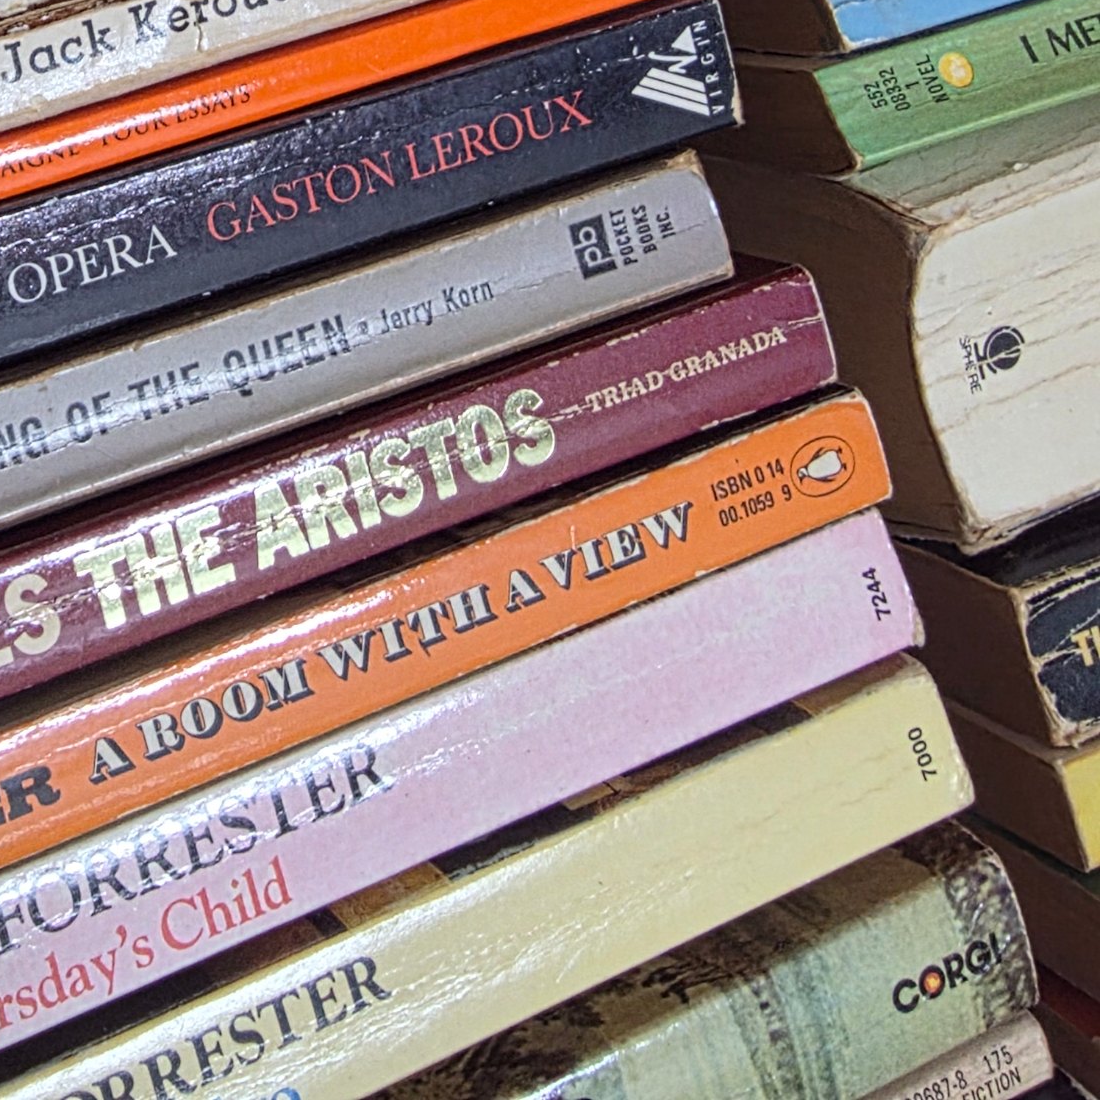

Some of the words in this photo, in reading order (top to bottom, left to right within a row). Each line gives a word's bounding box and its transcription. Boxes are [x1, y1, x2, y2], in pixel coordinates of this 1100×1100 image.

[2, 17, 119, 85] Jack
[693, 19, 723, 116] VIRGIN
[1020, 35, 1039, 63] I
[176, 83, 251, 124] ESSAYS
[864, 81, 888, 109] 552
[879, 66, 912, 112] 08332
[905, 81, 919, 90] 1
[916, 54, 950, 103] NOVEL
[207, 150, 395, 242] GASTON
[406, 89, 594, 180] LEROUX
[609, 209, 638, 266] POCKET
[631, 204, 657, 254] BOOKS
[656, 205, 676, 240] INC.
[7, 223, 177, 305] OPERA
[66, 391, 112, 443] OF
[127, 361, 210, 419] THE
[222, 314, 352, 397] QUEEN
[380, 299, 434, 335] Jerry
[441, 280, 495, 315] Korn
[959, 336, 983, 394] SPHERE
[710, 470, 753, 501] ISBN
[754, 466, 766, 484] 0
[766, 458, 785, 479] 14
[718, 490, 775, 527] 00.1059
[782, 484, 792, 501] 9
[74, 504, 237, 631] THE
[253, 387, 557, 571] ARISTOS
[862, 567, 892, 622] 7244
[89, 735, 133, 785] A
[136, 657, 315, 762] ROOM
[316, 583, 500, 681] WITH
[504, 567, 547, 613] A
[540, 502, 694, 590] VIEW
[908, 726, 937, 782] 7000
[159, 854, 293, 953] Child
[891, 933, 1003, 1014] CORGI
[983, 1045, 1013, 1075] 175
